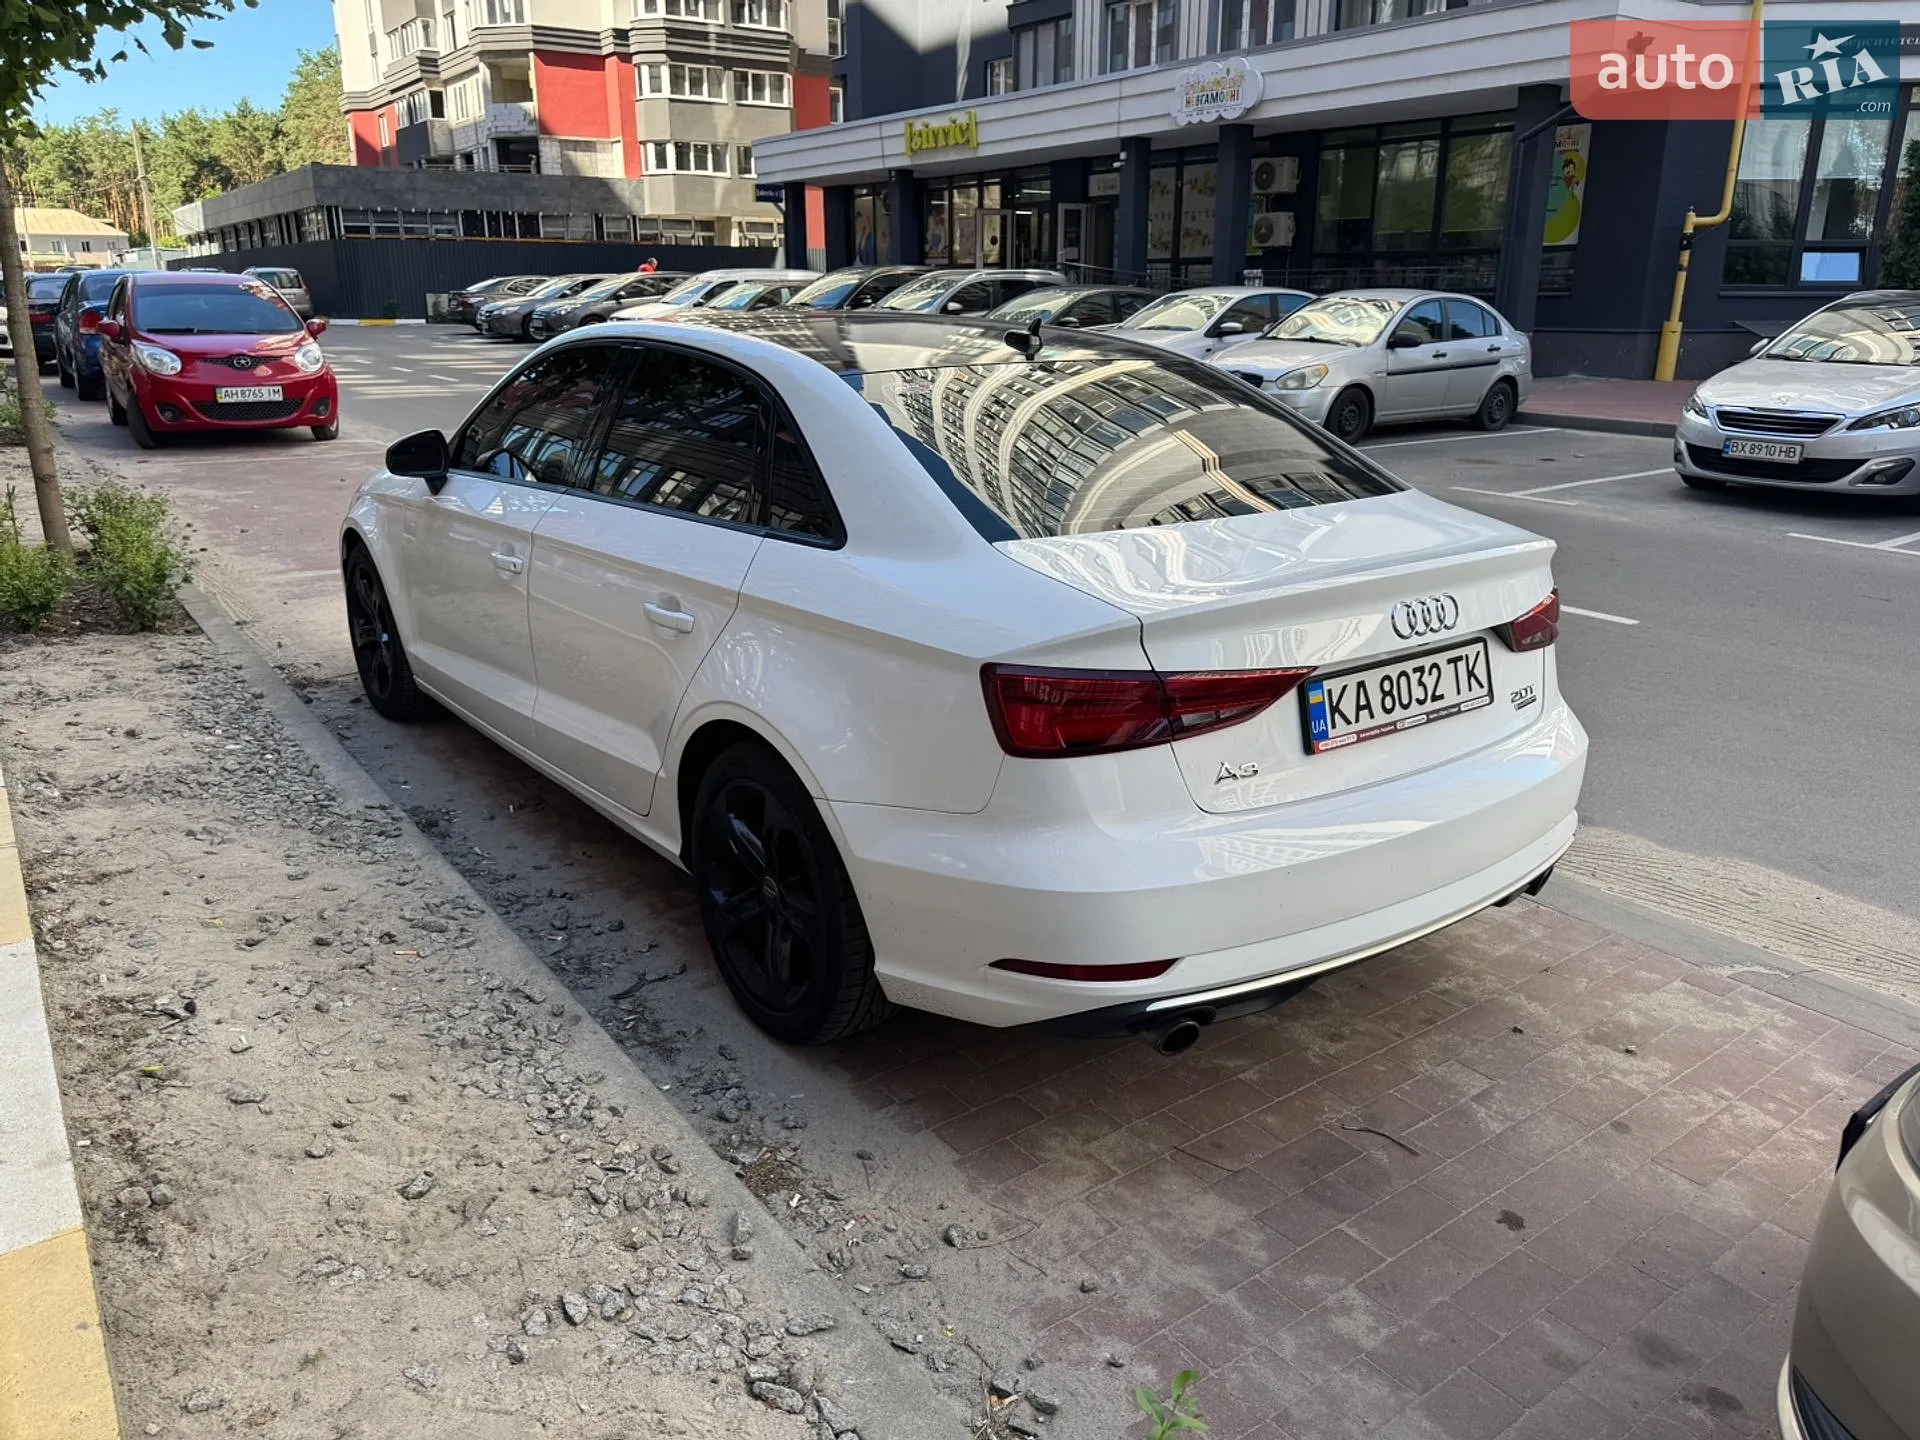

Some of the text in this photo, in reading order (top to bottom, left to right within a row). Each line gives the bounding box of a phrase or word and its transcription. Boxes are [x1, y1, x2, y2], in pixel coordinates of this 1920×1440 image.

[224, 389, 239, 399] AH
[240, 388, 264, 399] 8765
[1730, 441, 1797, 459] BX 8910 HB
[1327, 650, 1485, 730] KA 8032 TK
[1311, 719, 1327, 734] UA
